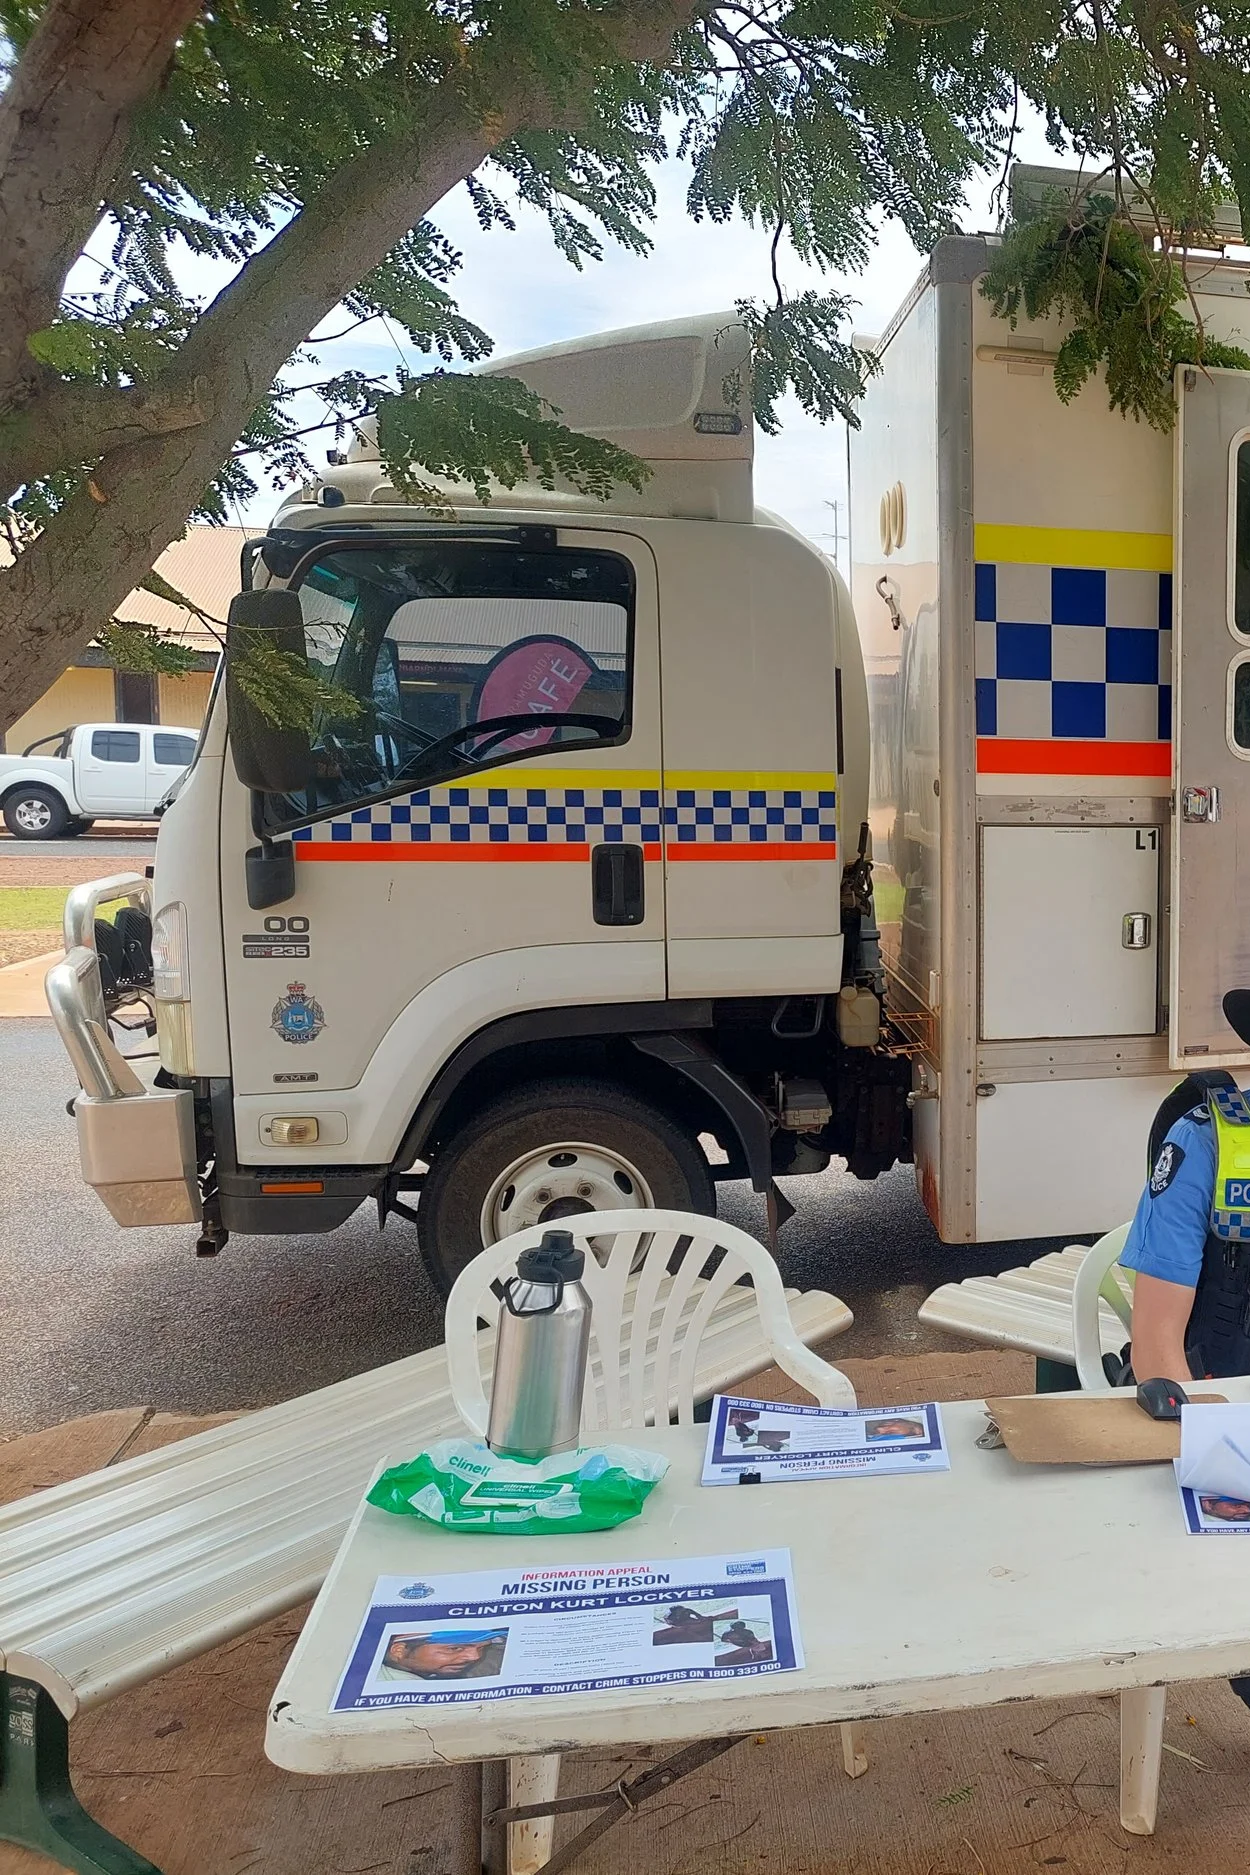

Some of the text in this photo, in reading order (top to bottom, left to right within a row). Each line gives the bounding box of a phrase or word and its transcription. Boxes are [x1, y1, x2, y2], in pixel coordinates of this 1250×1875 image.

[1135, 829, 1156, 850] L1
[272, 946, 308, 956] 235
[774, 1405, 801, 1413] STOPPERS
[755, 1453, 811, 1461] LOCKYER
[851, 1447, 902, 1455] CLINTON
[449, 1456, 491, 1478] clinell
[780, 1456, 876, 1469] MISSING PERSON
[521, 1566, 652, 1581] INFORMATION APPEAL
[501, 1574, 670, 1595] MISSING PERSON
[448, 1588, 715, 1616] CLINTON KURT LOCKYER
[354, 1698, 368, 1706] IF
[368, 1697, 392, 1705] YOU
[394, 1695, 425, 1704] HAVE
[427, 1694, 453, 1703] ANY
[455, 1686, 532, 1701] INFORMATION
[542, 1681, 594, 1693] CONTACT
[595, 1677, 630, 1689] CRIME
[633, 1670, 687, 1685] STOPPERS
[690, 1670, 704, 1678] ON
[708, 1669, 735, 1678] 1800
[737, 1667, 758, 1676] 333
[760, 1662, 781, 1672] 000
